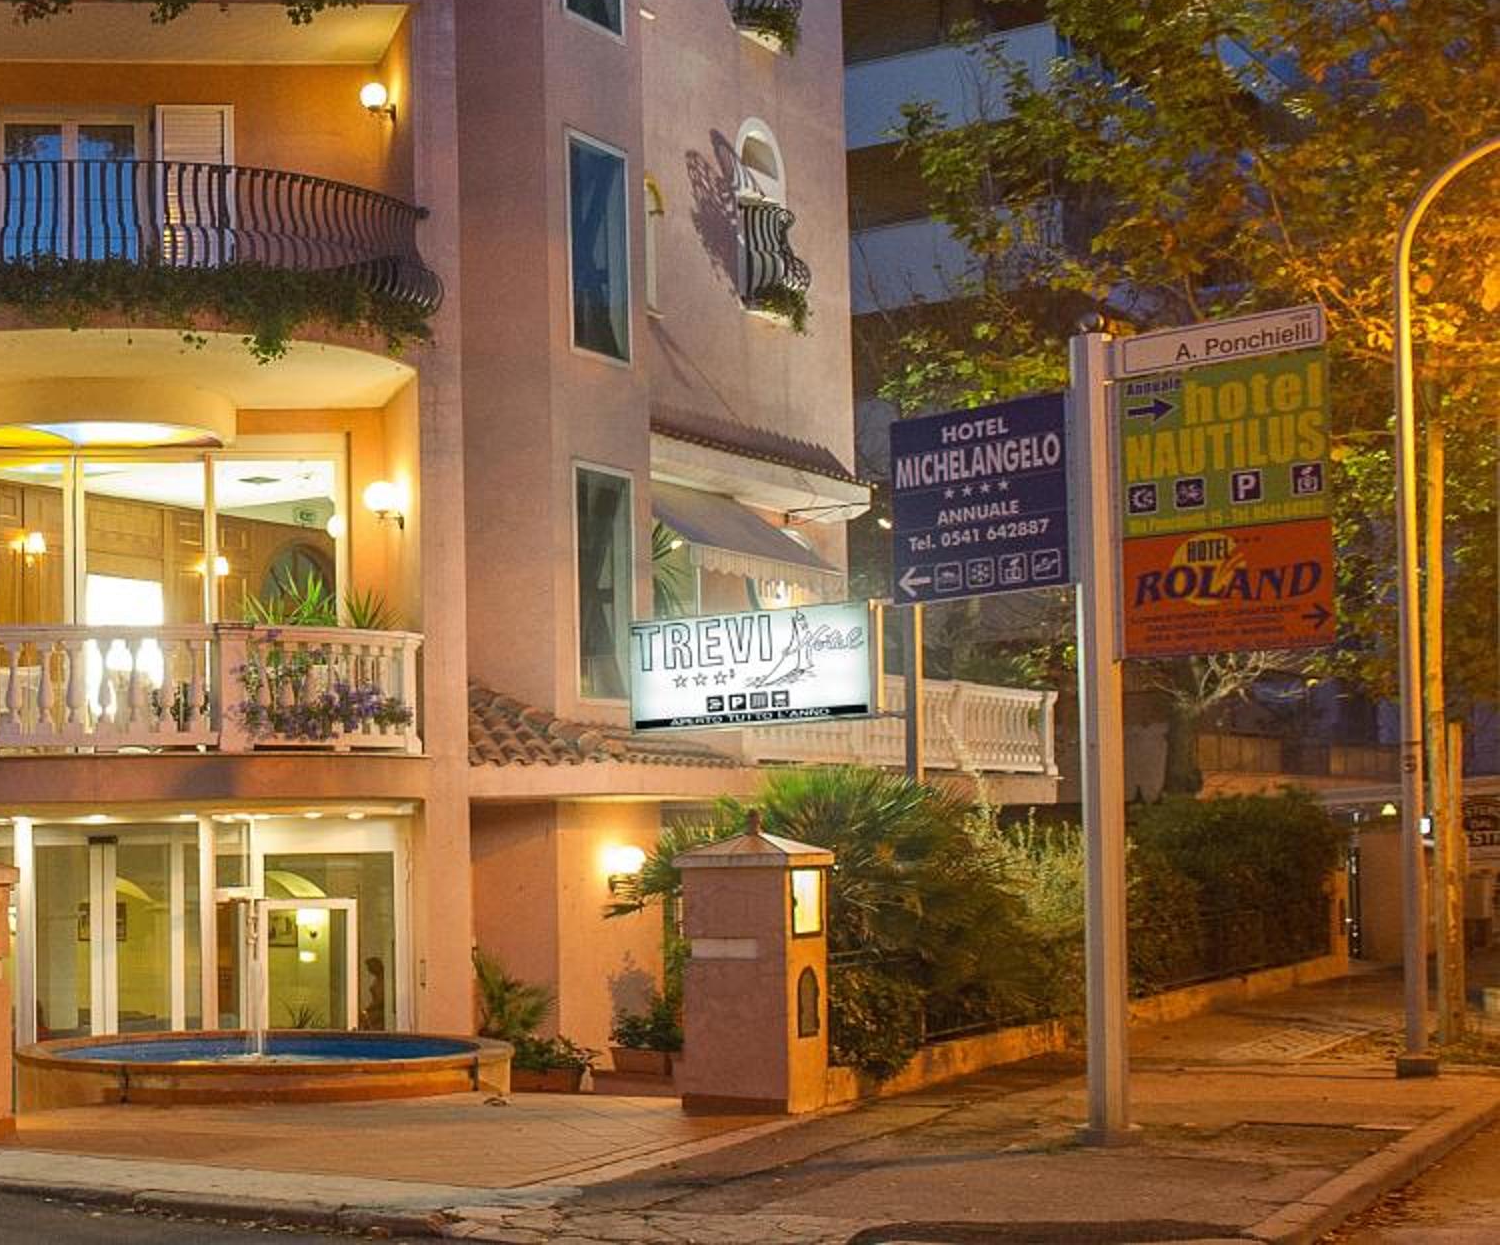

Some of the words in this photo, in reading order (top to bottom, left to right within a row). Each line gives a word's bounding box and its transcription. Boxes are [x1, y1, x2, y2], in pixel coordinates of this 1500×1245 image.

[1175, 343, 1197, 361] A.
[1205, 321, 1312, 355] Ponchielli
[1183, 361, 1323, 424] hotel
[941, 417, 1009, 443] HOTEL
[1125, 411, 1326, 482] NAUTILUS
[895, 433, 1060, 490] MICHELANGELO
[937, 500, 1020, 526] ANNUALE
[908, 535, 936, 551] Tel.
[941, 529, 980, 547] 0541
[986, 518, 1050, 541] 642887
[1187, 538, 1228, 562] HOTEL
[1135, 560, 1322, 606] ROLAND
[632, 614, 773, 671] TREVI
[728, 712, 772, 723] TUTTO
[777, 708, 830, 719] L'ANNO
